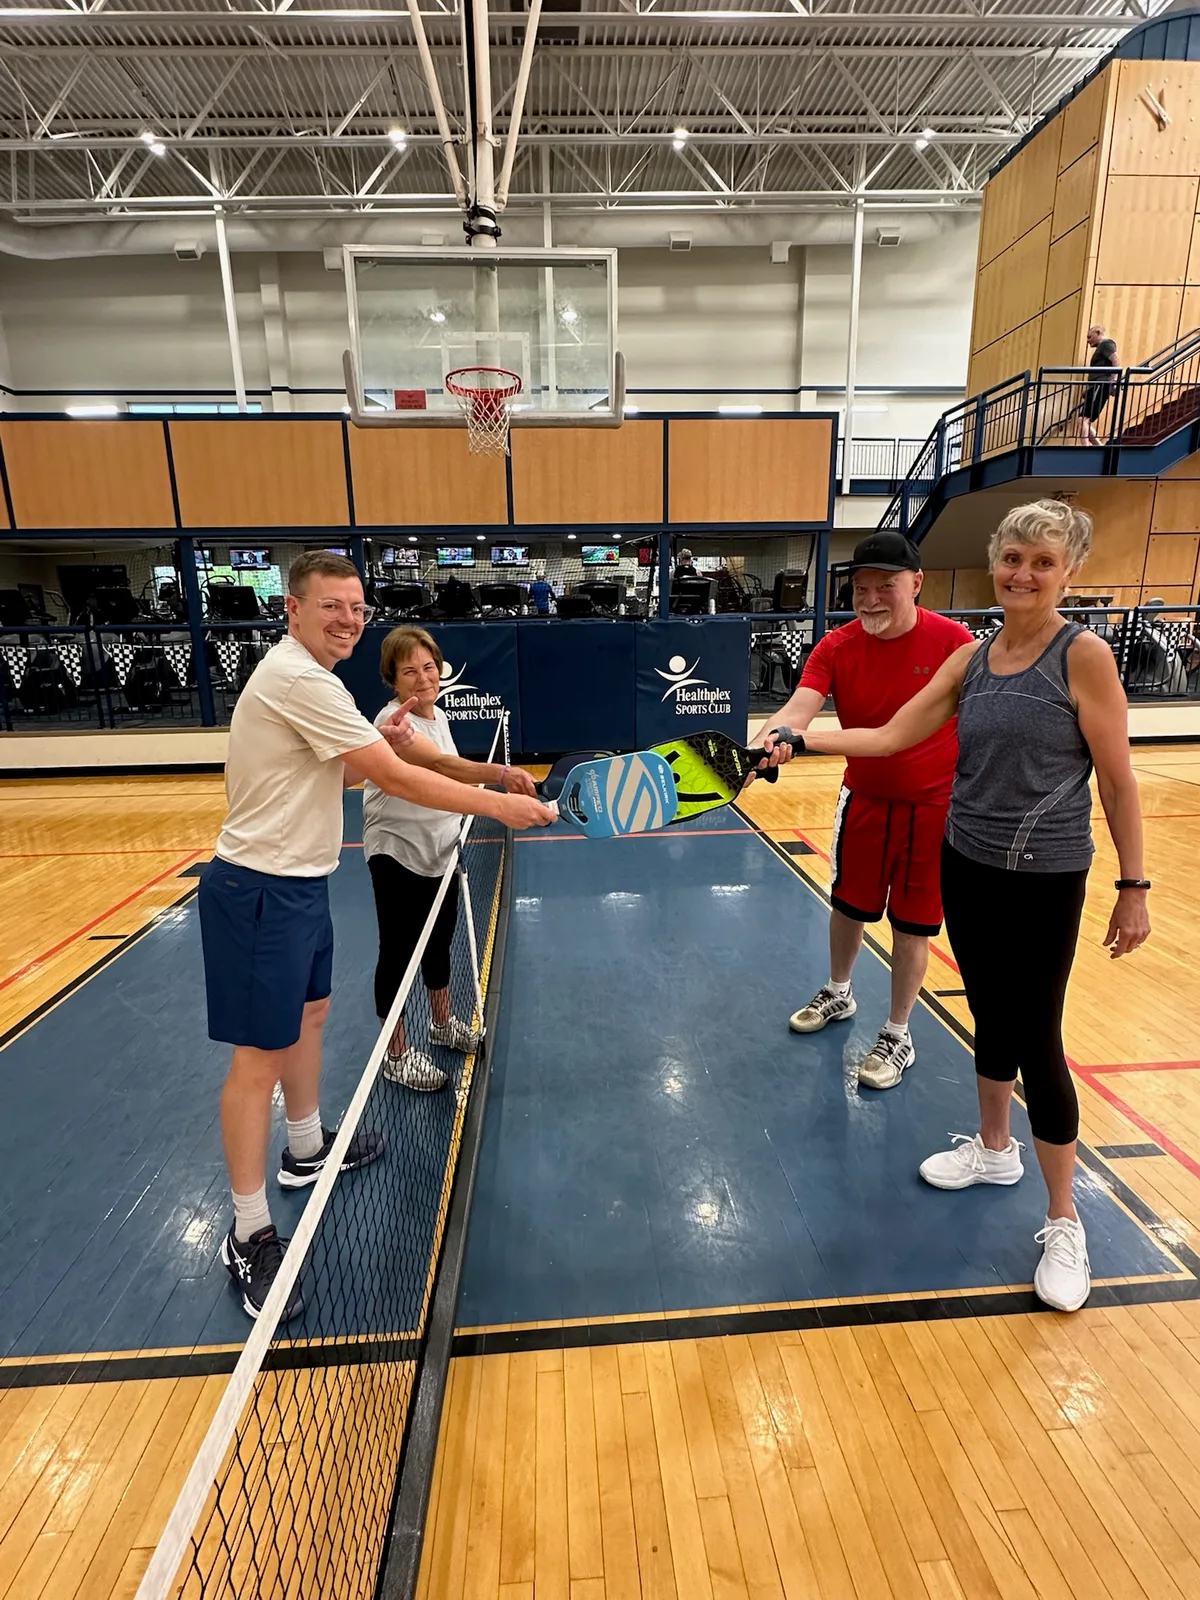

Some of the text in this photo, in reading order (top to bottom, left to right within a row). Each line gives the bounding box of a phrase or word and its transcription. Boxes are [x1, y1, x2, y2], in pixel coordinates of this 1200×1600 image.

[444, 693, 501, 709] Healthplex
[676, 687, 731, 703] Healthplex
[445, 709, 478, 721] SPORTS
[675, 702, 731, 715] SPORTS CLUB
